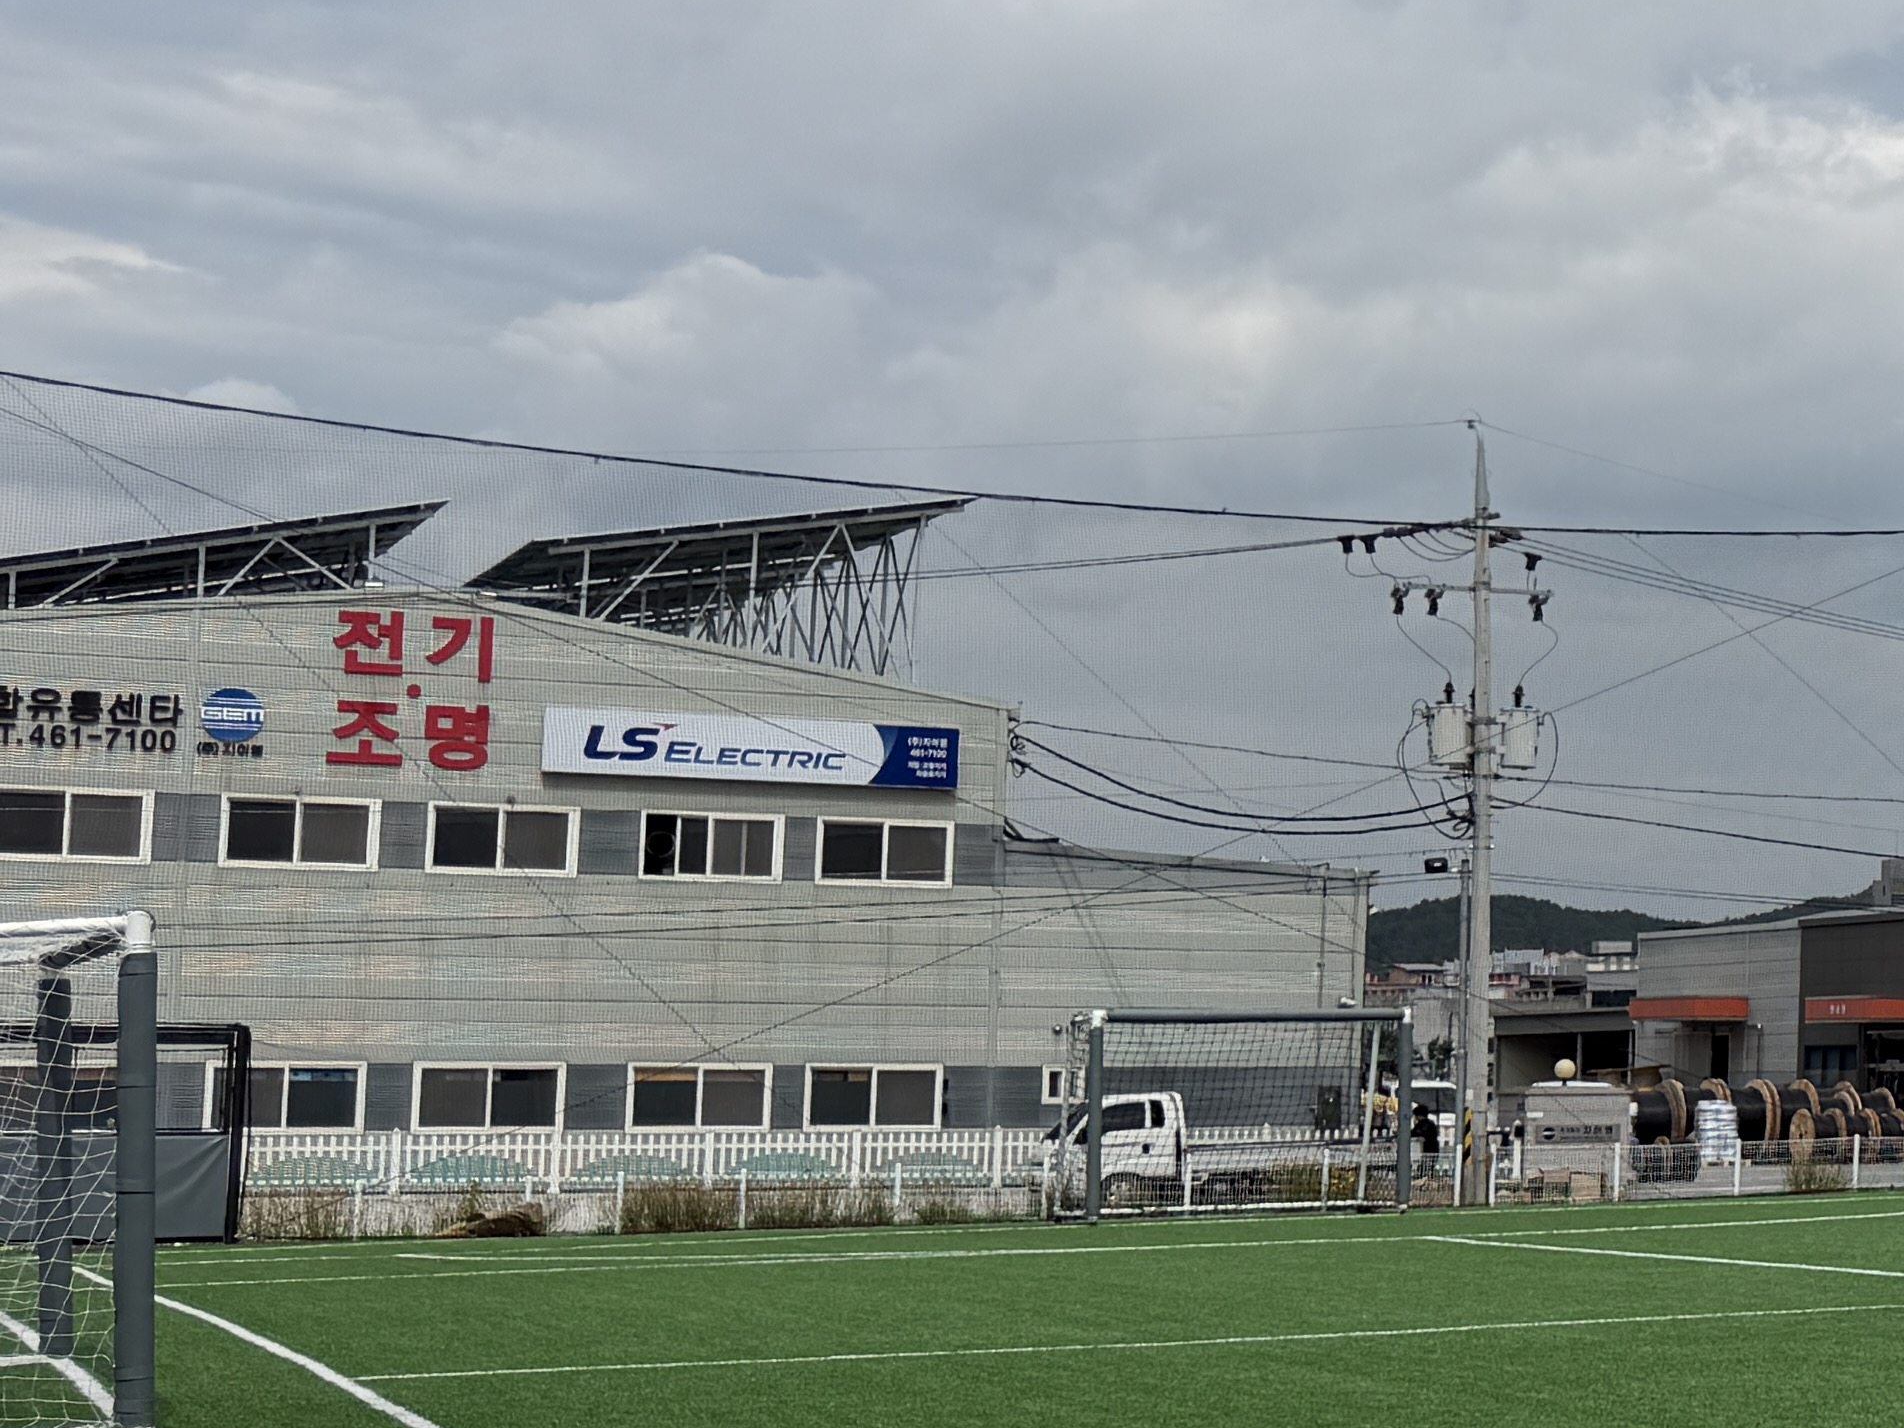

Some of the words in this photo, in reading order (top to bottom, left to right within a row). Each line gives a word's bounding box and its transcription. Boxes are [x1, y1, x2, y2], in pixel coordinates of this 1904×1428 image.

[332, 609, 494, 684] 전기
[325, 699, 490, 772] 조명
[583, 724, 662, 761] LS
[664, 741, 847, 771] ELECTRIC
